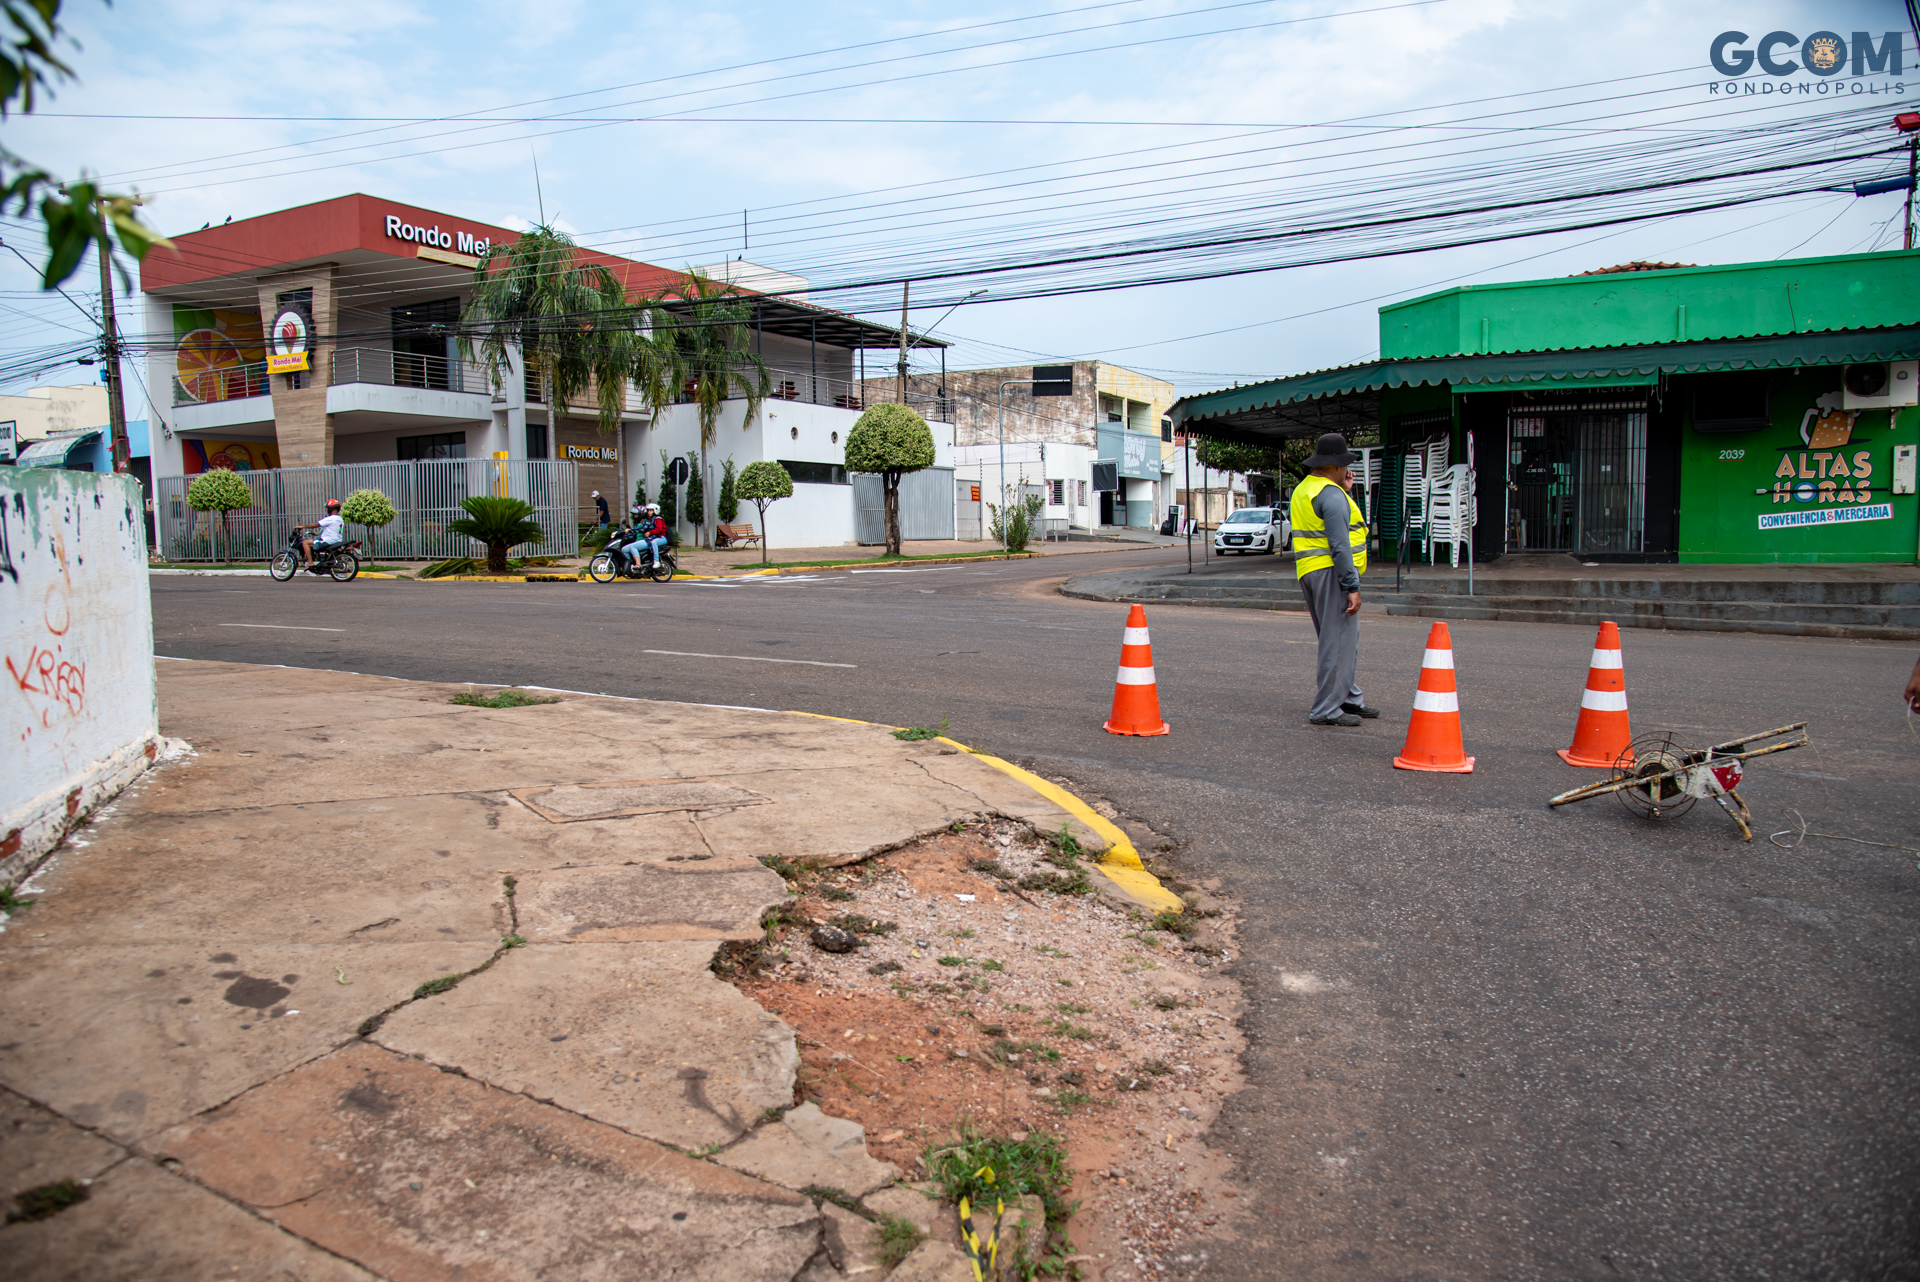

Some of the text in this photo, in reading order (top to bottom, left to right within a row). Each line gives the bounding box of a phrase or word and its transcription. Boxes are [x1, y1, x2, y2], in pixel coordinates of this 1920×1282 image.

[384, 214, 490, 257] Rondo Mel
[273, 354, 302, 367] Rondo Mel
[567, 446, 617, 460] Rondo Mel
[1719, 449, 1745, 459] 2039
[1774, 451, 1873, 479] ALTAS
[1772, 480, 1873, 504] HORAS
[1834, 505, 1890, 521] MERCEARIA
